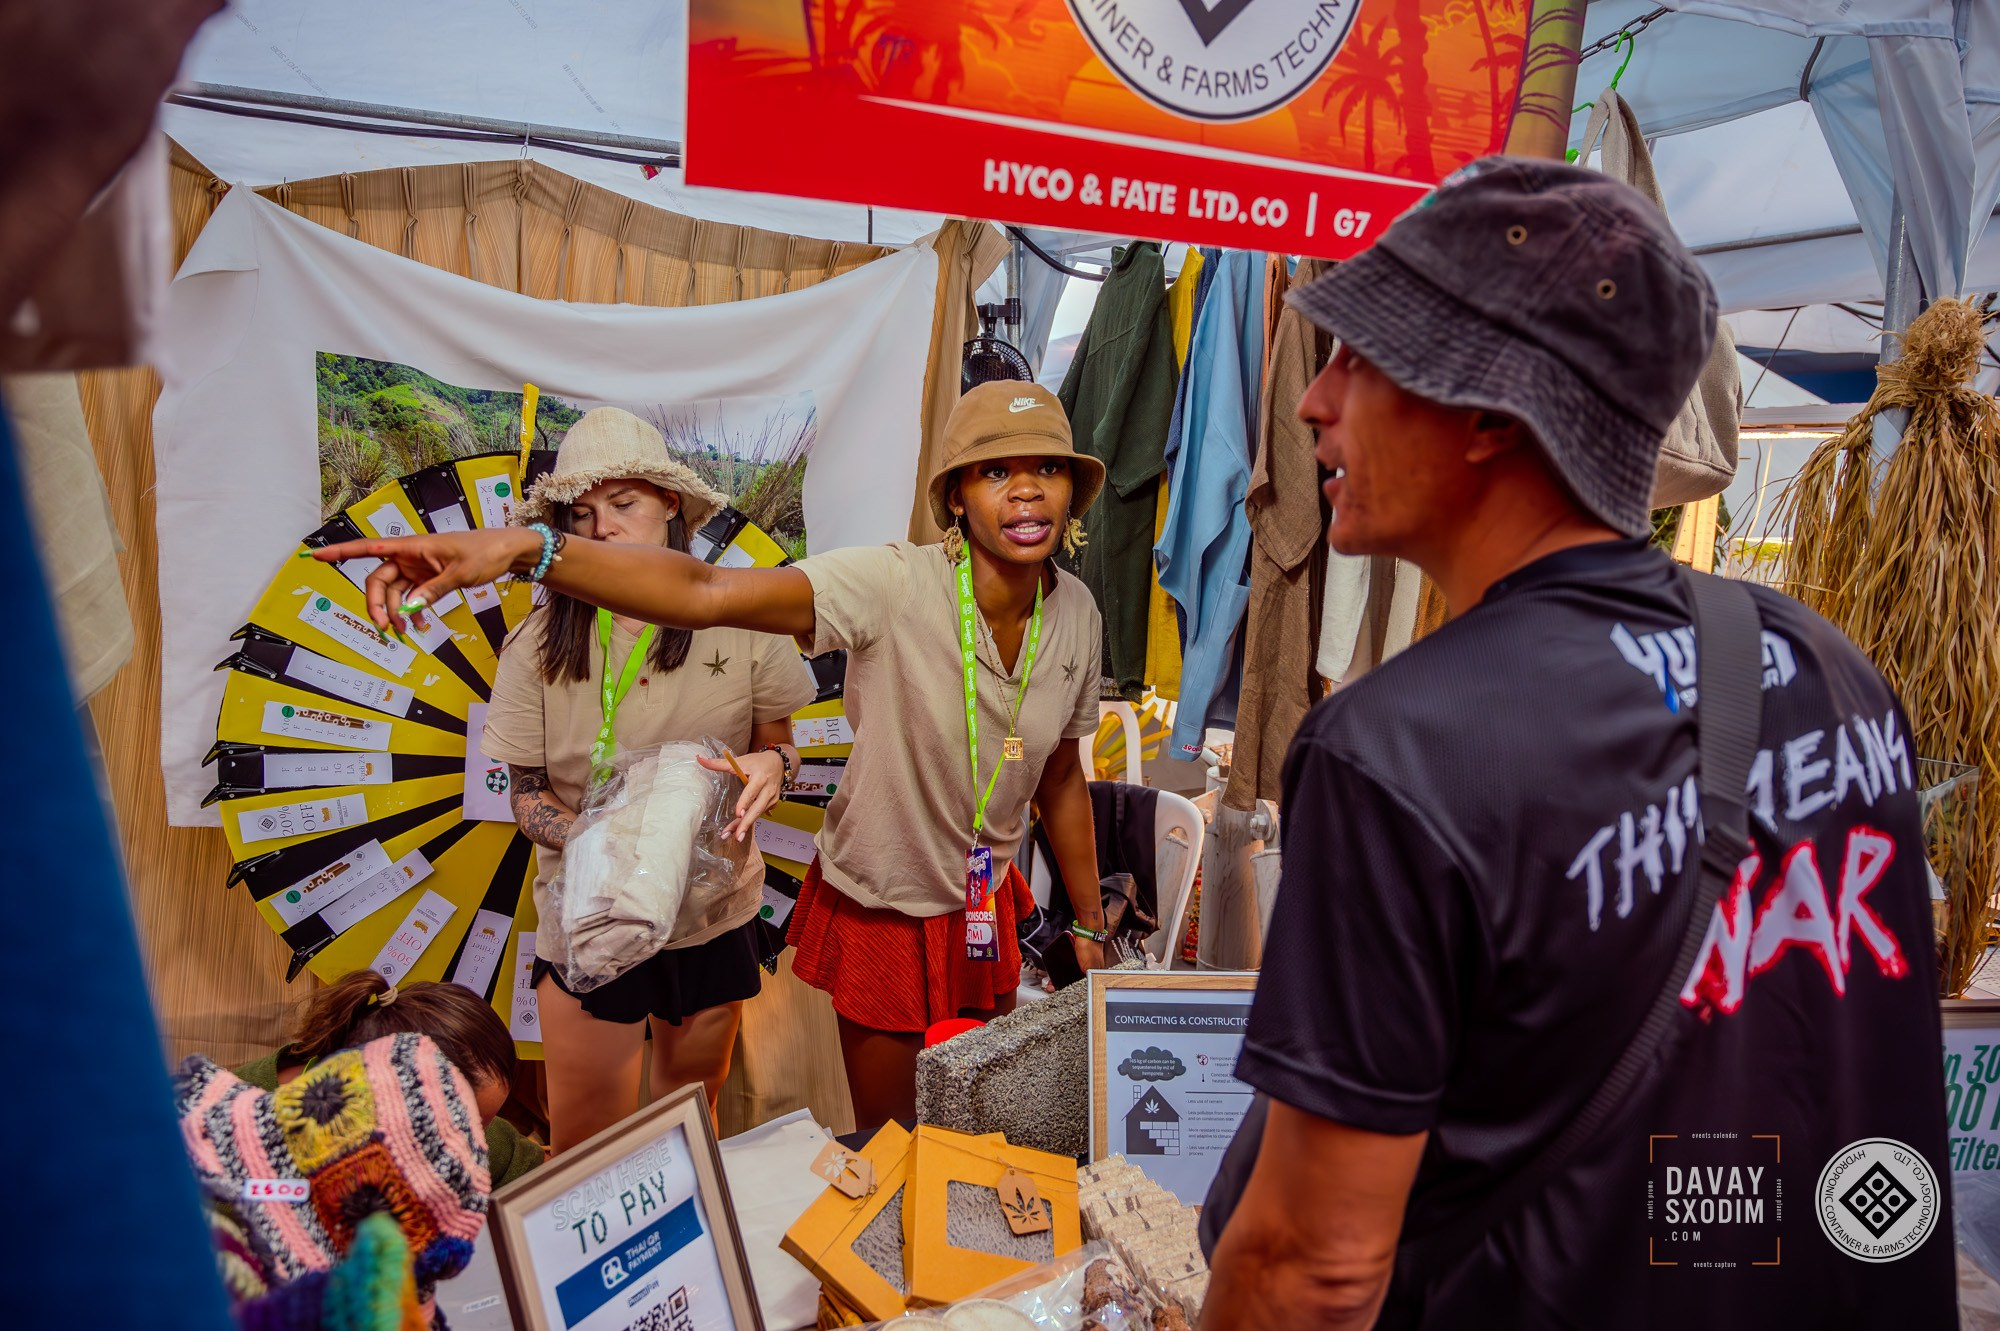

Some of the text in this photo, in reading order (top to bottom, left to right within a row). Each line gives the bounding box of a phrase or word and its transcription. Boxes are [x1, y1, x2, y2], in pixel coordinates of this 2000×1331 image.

[1156, 55, 1173, 86] &
[1181, 63, 1269, 99] FARMS
[983, 158, 1372, 239] HYCO & FATE LTD.CO G7
[1013, 397, 1036, 407] NIKE
[480, 485, 493, 494] X5
[304, 606, 320, 625] X10
[361, 679, 375, 698] Black
[369, 678, 387, 708] Patronus
[280, 716, 290, 732] X10
[825, 718, 841, 745] BIG
[346, 763, 354, 774] LA
[358, 765, 366, 781] Kush
[276, 804, 294, 836] 20%
[299, 801, 317, 832] OFF
[395, 929, 423, 952] OFF
[384, 943, 413, 967] 50%
[515, 995, 536, 1007] 0%
[1114, 1015, 1177, 1026] CONTRACTING
[1179, 1016, 1187, 1025] &
[552, 1138, 672, 1231] SCAN HERE
[572, 1170, 667, 1254] TO PAY
[625, 1238, 647, 1261] THAI
[627, 1242, 662, 1271] PAYMENT
